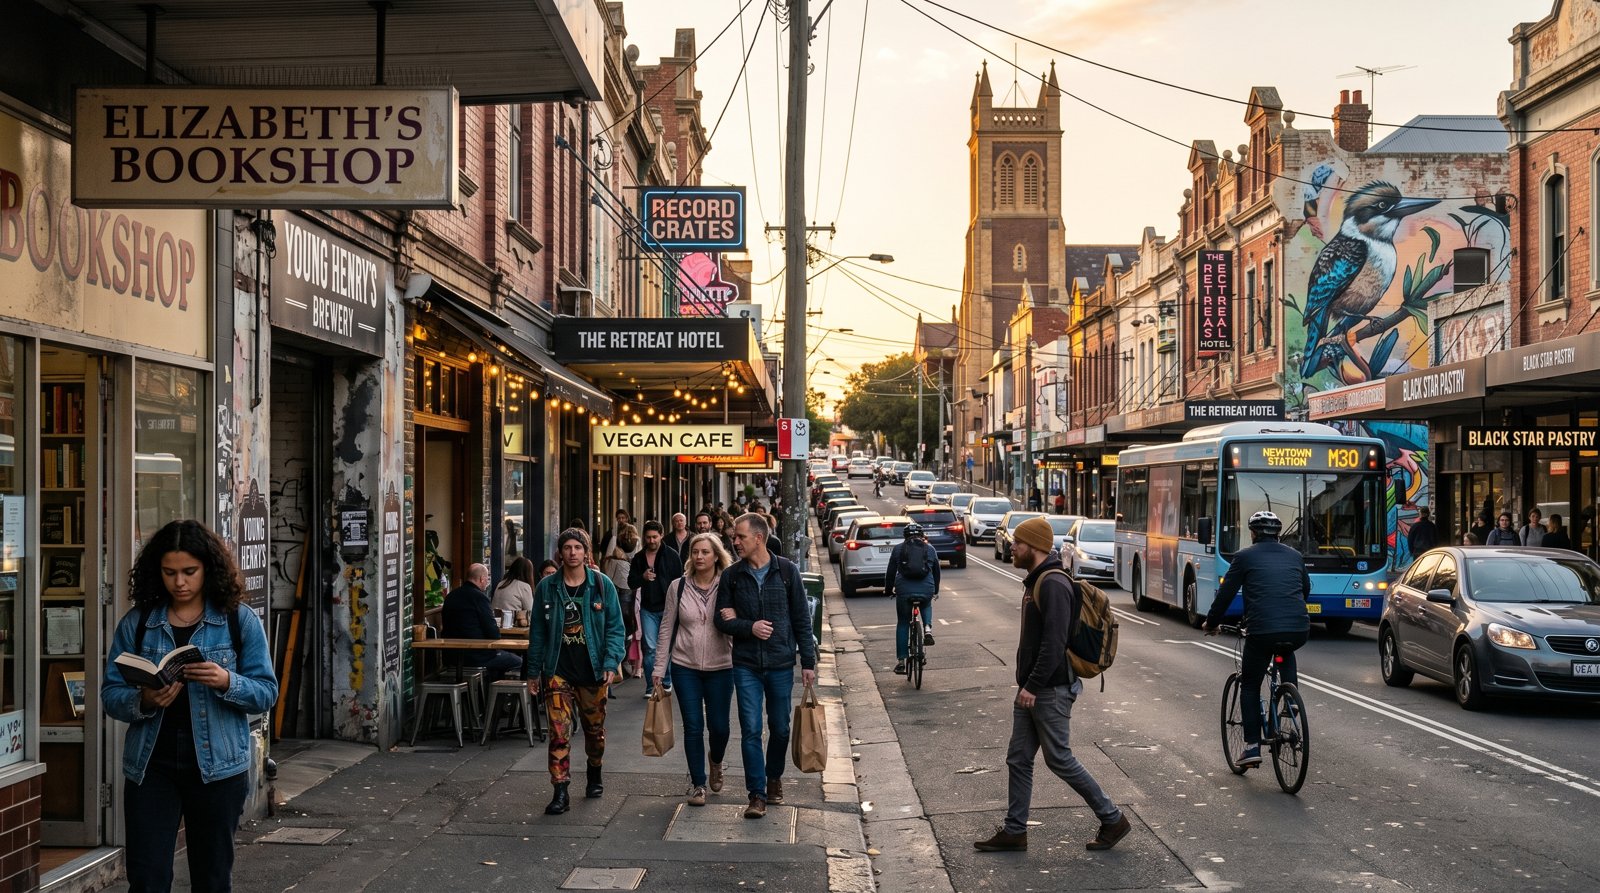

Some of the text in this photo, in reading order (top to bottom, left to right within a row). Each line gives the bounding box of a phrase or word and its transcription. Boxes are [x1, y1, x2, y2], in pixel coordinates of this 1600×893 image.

[103, 105, 423, 141] ELIZABETH'S
[110, 147, 415, 184] BOOKSHOP
[652, 199, 735, 219] RECORD
[0, 168, 195, 311] BOOKSHOP
[652, 220, 734, 239] CRATES
[284, 220, 377, 309] YOUNG HENRY'S
[313, 294, 354, 338] BREWERY
[578, 331, 724, 349] THE RETREAT HOTEL
[1522, 347, 1576, 372] BLACK STAR PASTRY
[1403, 375, 1422, 401] BLACK
[1423, 372, 1439, 399] STAR
[1440, 368, 1465, 396] PASTRY
[1189, 406, 1277, 417] THE RETREAT HOTEL
[602, 432, 733, 448] VEGAN CAFE
[1469, 431, 1596, 446] BLACK STAR PASTRY
[1262, 448, 1312, 458] NEWTOWN
[1268, 457, 1307, 467] STATION
[1328, 449, 1359, 468] M30
[243, 517, 265, 541] YOUNG
